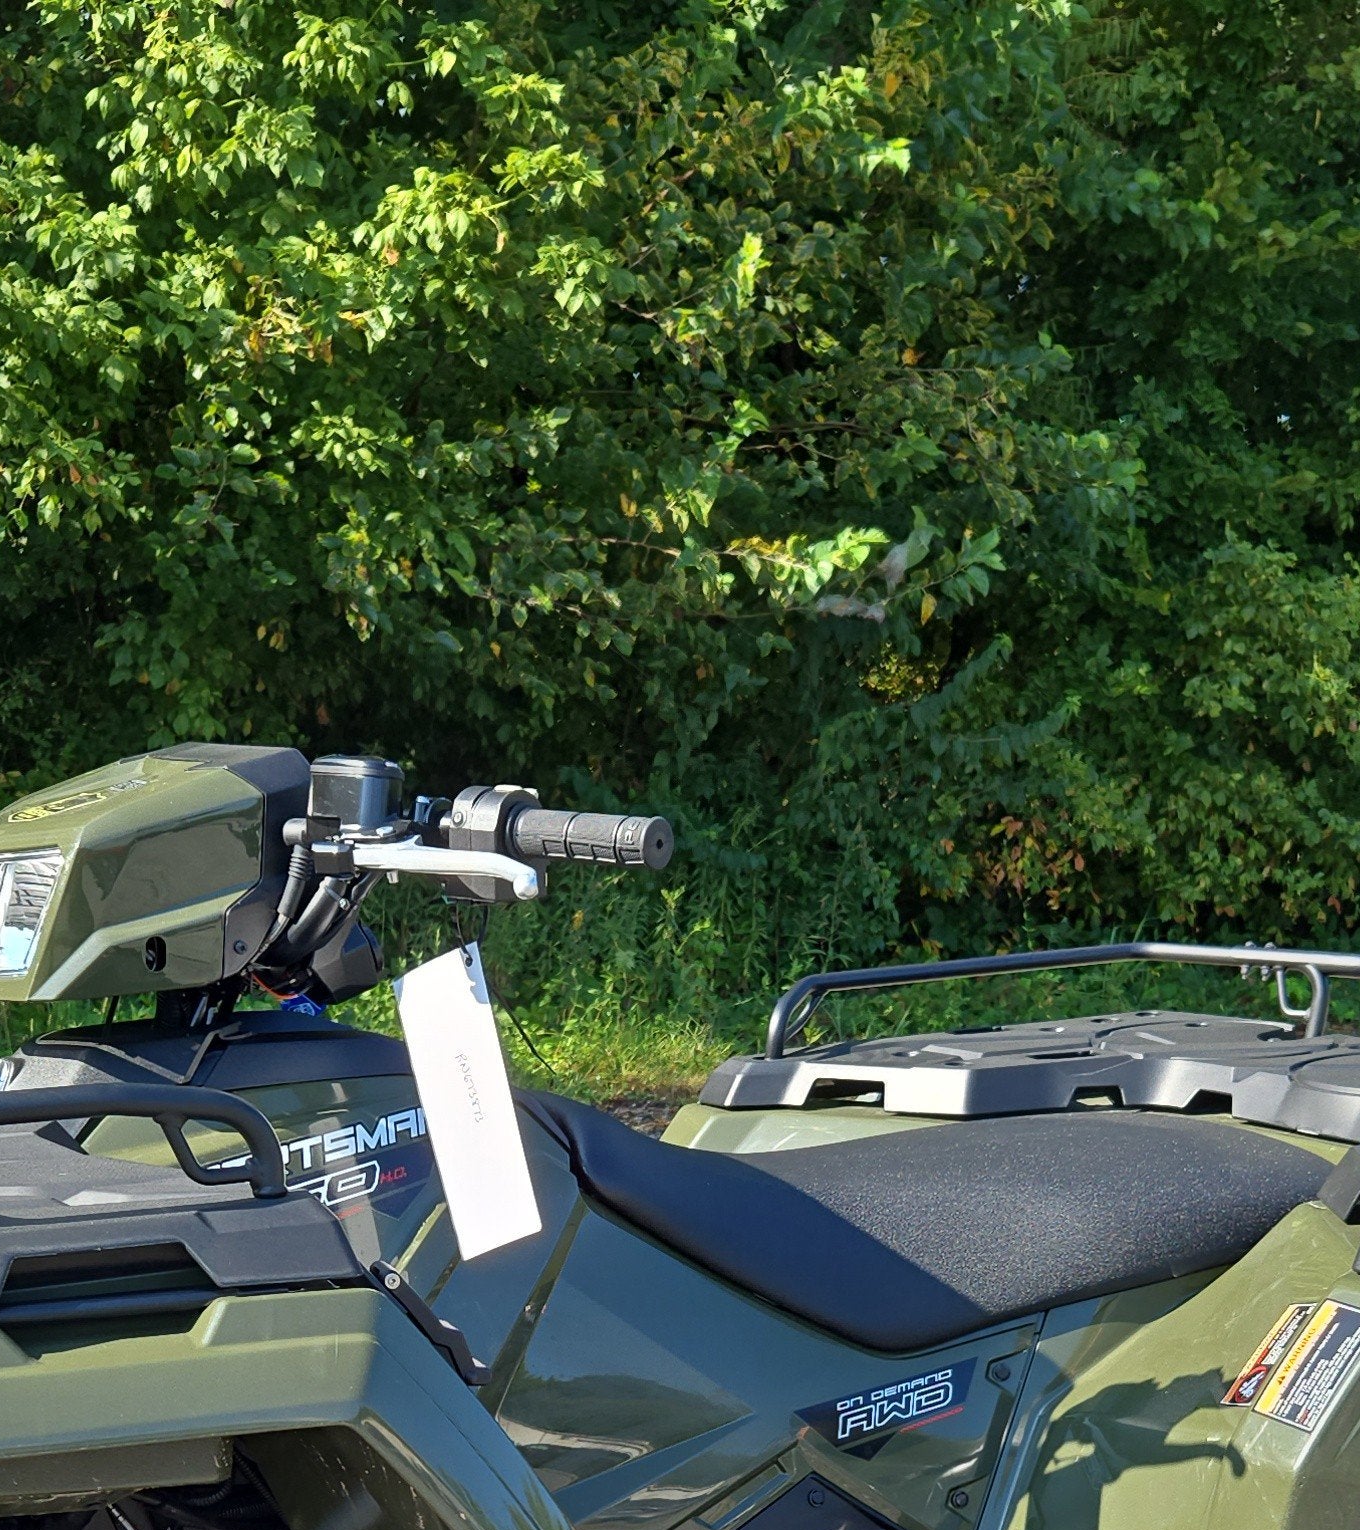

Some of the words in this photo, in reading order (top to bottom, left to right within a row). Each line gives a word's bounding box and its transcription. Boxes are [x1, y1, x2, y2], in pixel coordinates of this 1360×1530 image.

[1283, 1327, 1317, 1373] WARNING
[836, 1395, 864, 1412] ON
[870, 1368, 953, 1401] DEMAND
[837, 1381, 954, 1440] AWD
